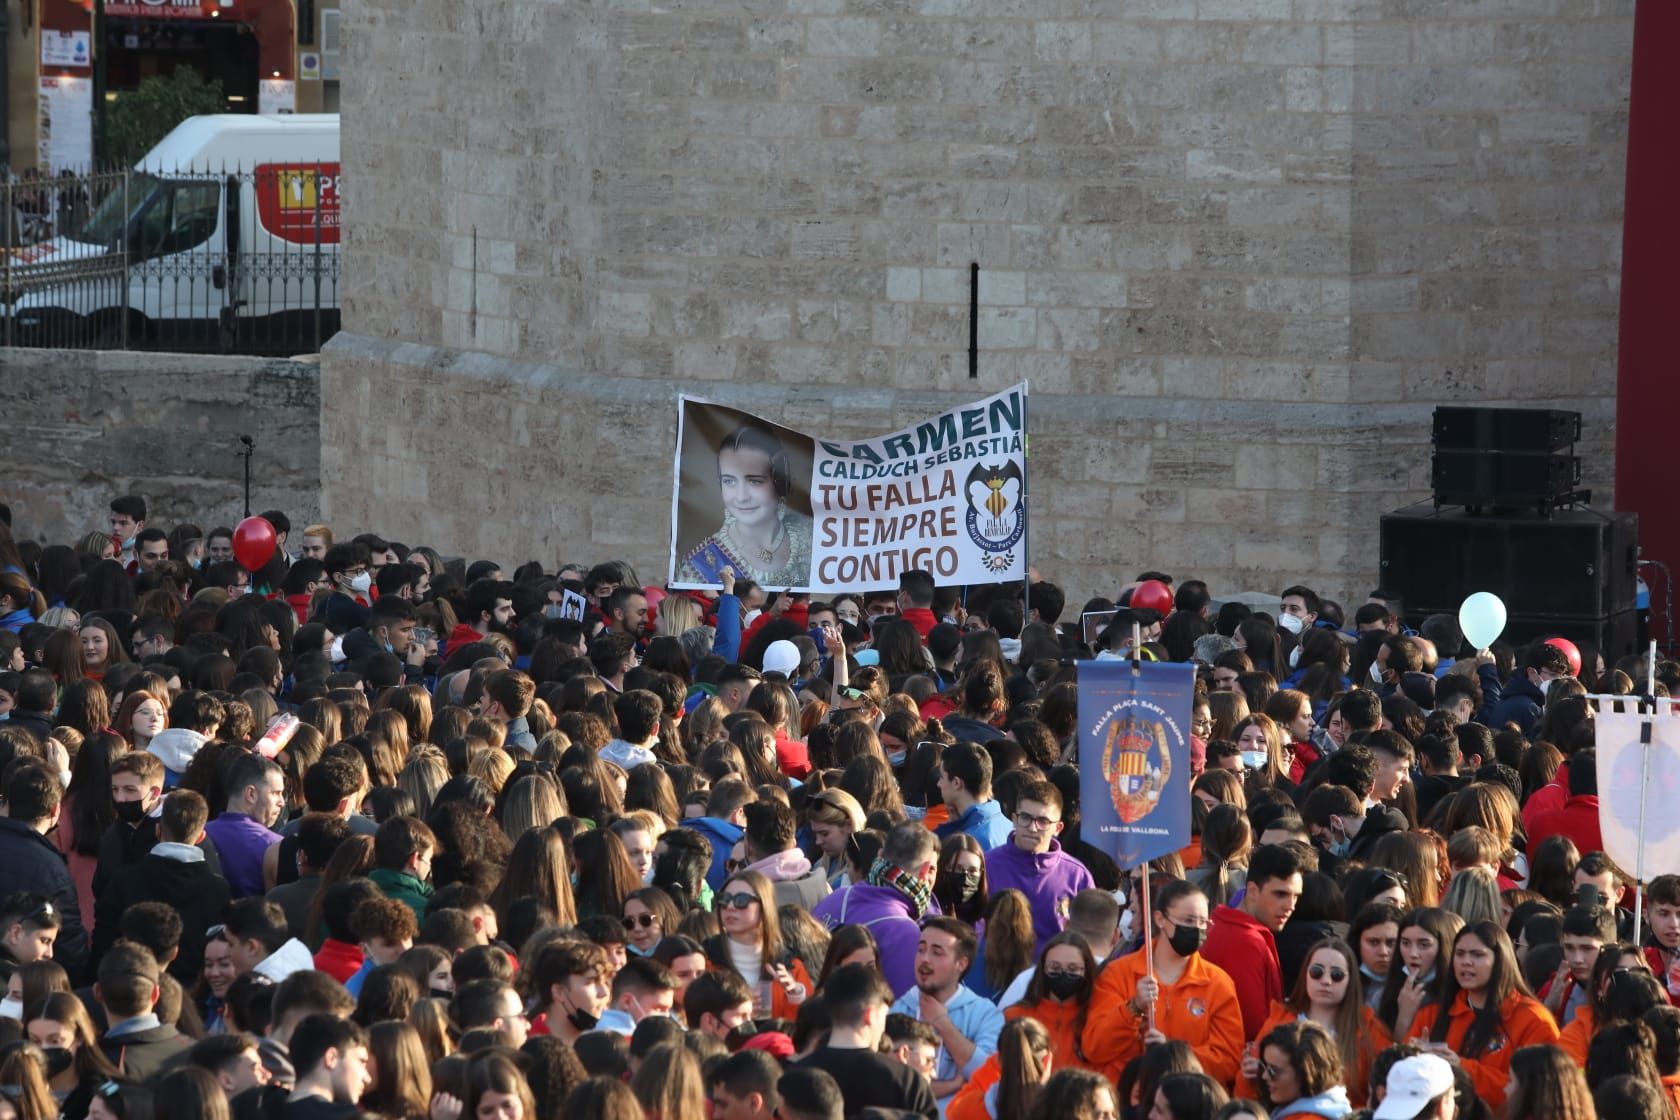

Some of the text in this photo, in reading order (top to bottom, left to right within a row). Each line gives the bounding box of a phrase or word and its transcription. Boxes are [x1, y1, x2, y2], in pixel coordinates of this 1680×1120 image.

[819, 431, 1022, 480] CALDUCH SEBASTIÁ
[818, 469, 957, 512] TU FALLA
[821, 506, 958, 547] SIEMPRE
[818, 545, 959, 585] CONTIGO
[1092, 699, 1185, 746] FALLA PLAÇA SANT JAUME
[1100, 825, 1109, 833] LA
[1130, 826, 1170, 837] VALLBONA
